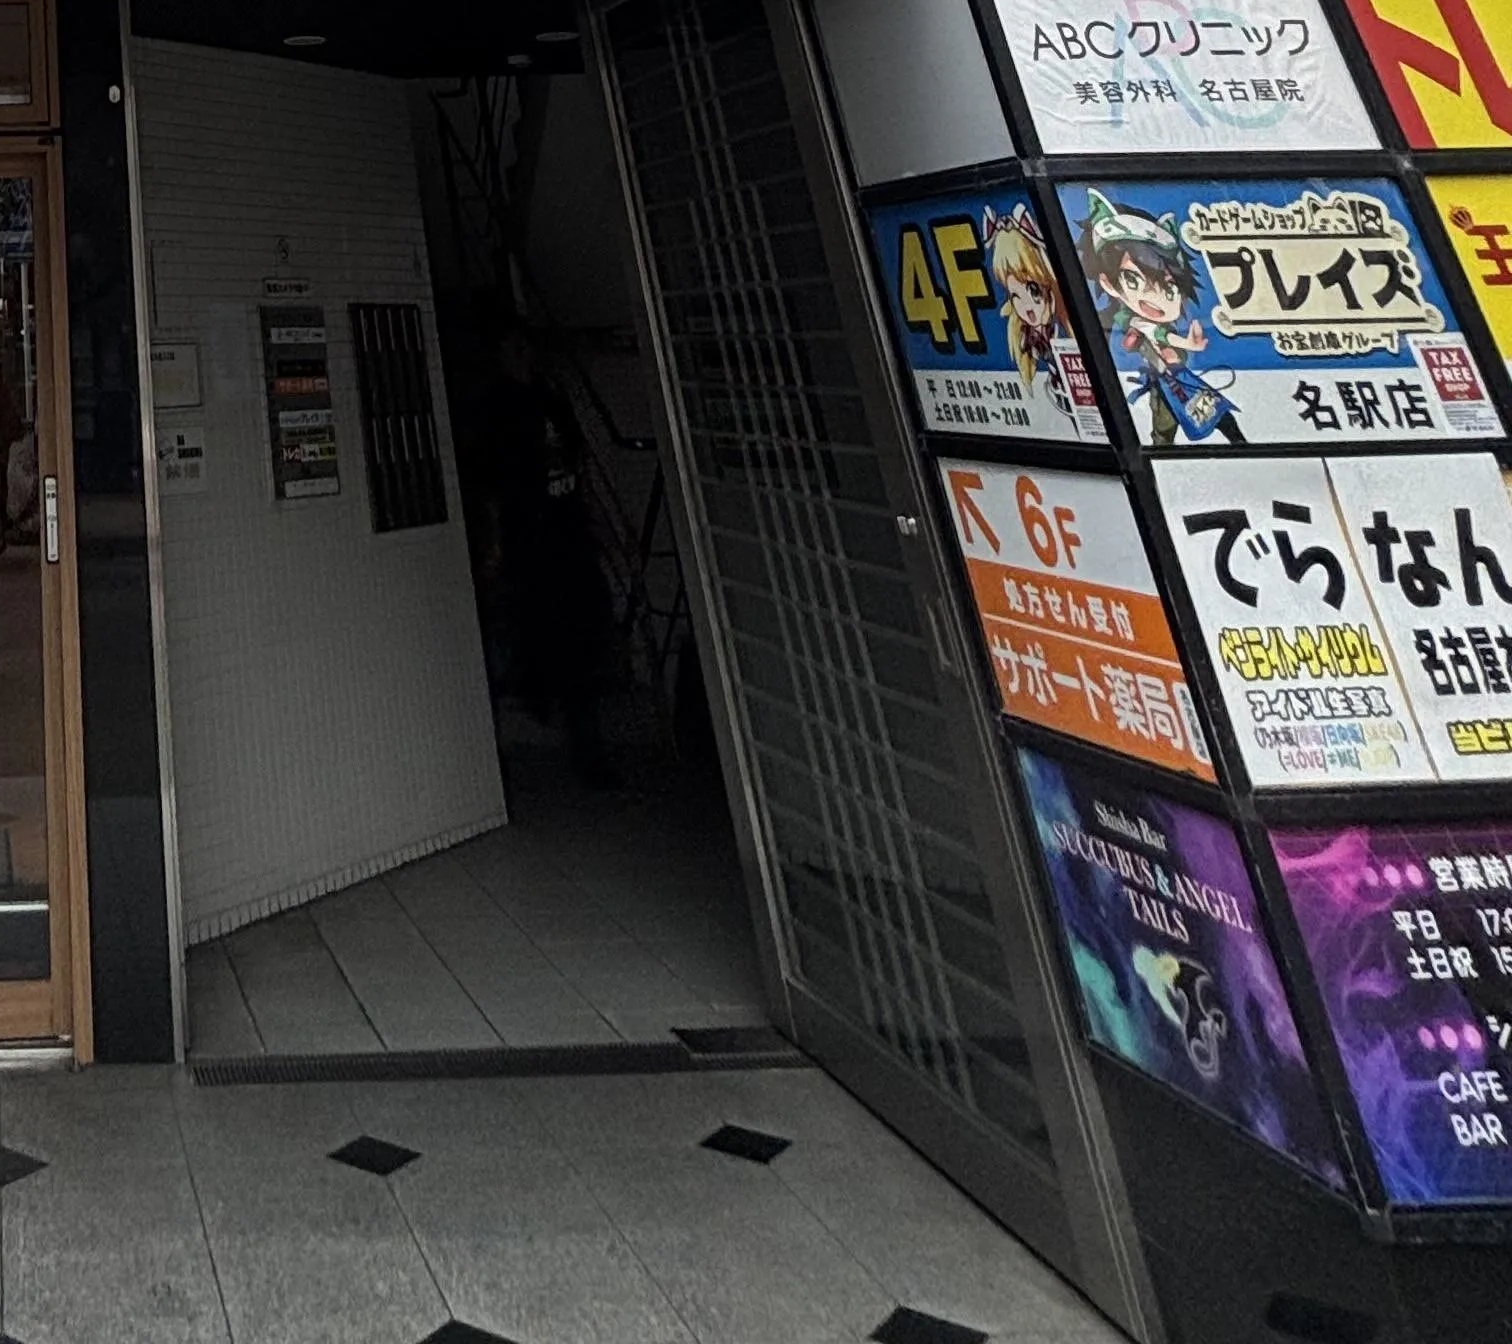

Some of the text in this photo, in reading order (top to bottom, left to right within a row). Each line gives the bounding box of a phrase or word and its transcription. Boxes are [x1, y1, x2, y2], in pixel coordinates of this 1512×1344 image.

[1033, 19, 1311, 61] ABCクリニック
[1073, 77, 1305, 105] 美容外科 名古屋院
[1194, 206, 1307, 233] カードゲームショップ
[901, 221, 990, 343] 4F
[1203, 245, 1424, 312] プレイズ
[1428, 351, 1463, 366] TAX
[1431, 367, 1474, 383] FREE
[1291, 378, 1436, 432] 名駅店
[1014, 474, 1082, 570] 6F
[1002, 575, 1136, 642] 処方せん受付
[990, 633, 1185, 751] サポート薬局
[1445, 717, 1512, 756] 当ビ
[1137, 815, 1168, 852] Bar
[1154, 863, 1175, 900] &
[1428, 855, 1512, 894] 営業時
[1121, 884, 1191, 945] TAILS
[1392, 908, 1443, 943] 平日
[1406, 945, 1481, 981] 土日祝
[1438, 1069, 1509, 1105] CAFE
[1450, 1112, 1509, 1148] BAR
